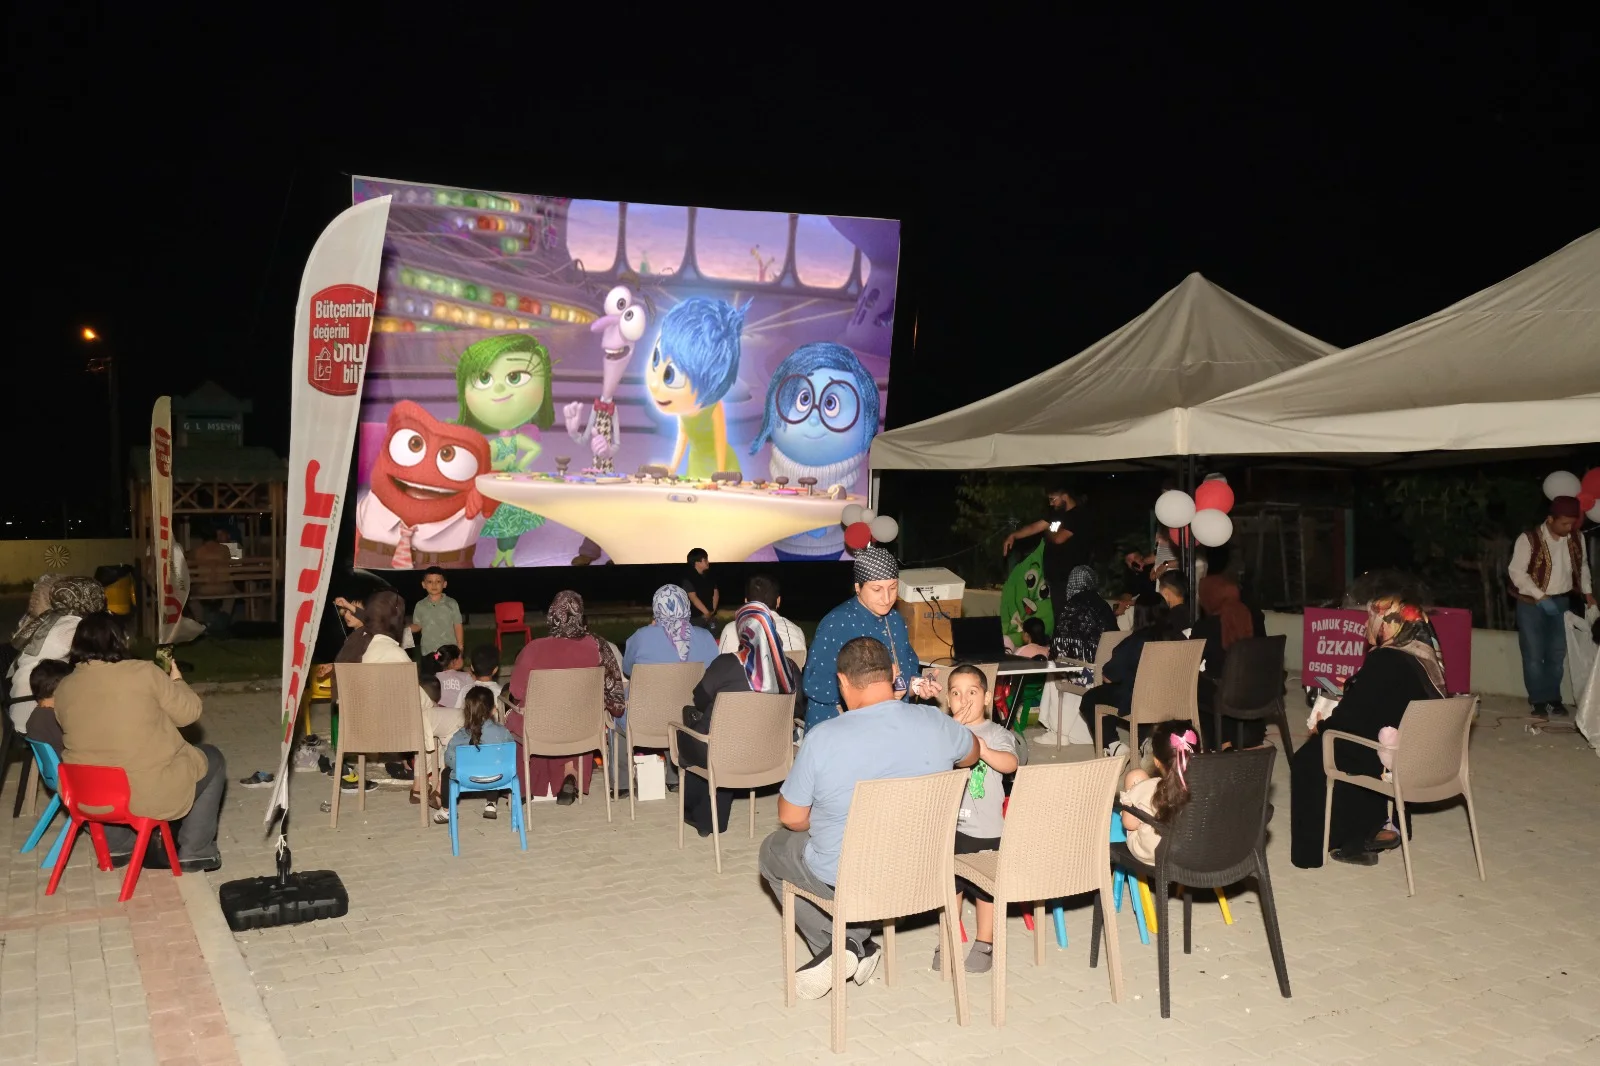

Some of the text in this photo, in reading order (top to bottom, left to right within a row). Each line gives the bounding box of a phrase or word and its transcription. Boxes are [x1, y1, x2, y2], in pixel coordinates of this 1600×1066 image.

[315, 299, 373, 323] Bütçenizin
[313, 323, 350, 342] değerini
[1311, 619, 1341, 633] PAMUK
[1316, 636, 1364, 656] ÖZKAN
[1308, 661, 1333, 674] 0506
[1335, 664, 1355, 677] 384
[443, 679, 461, 691] 1969
